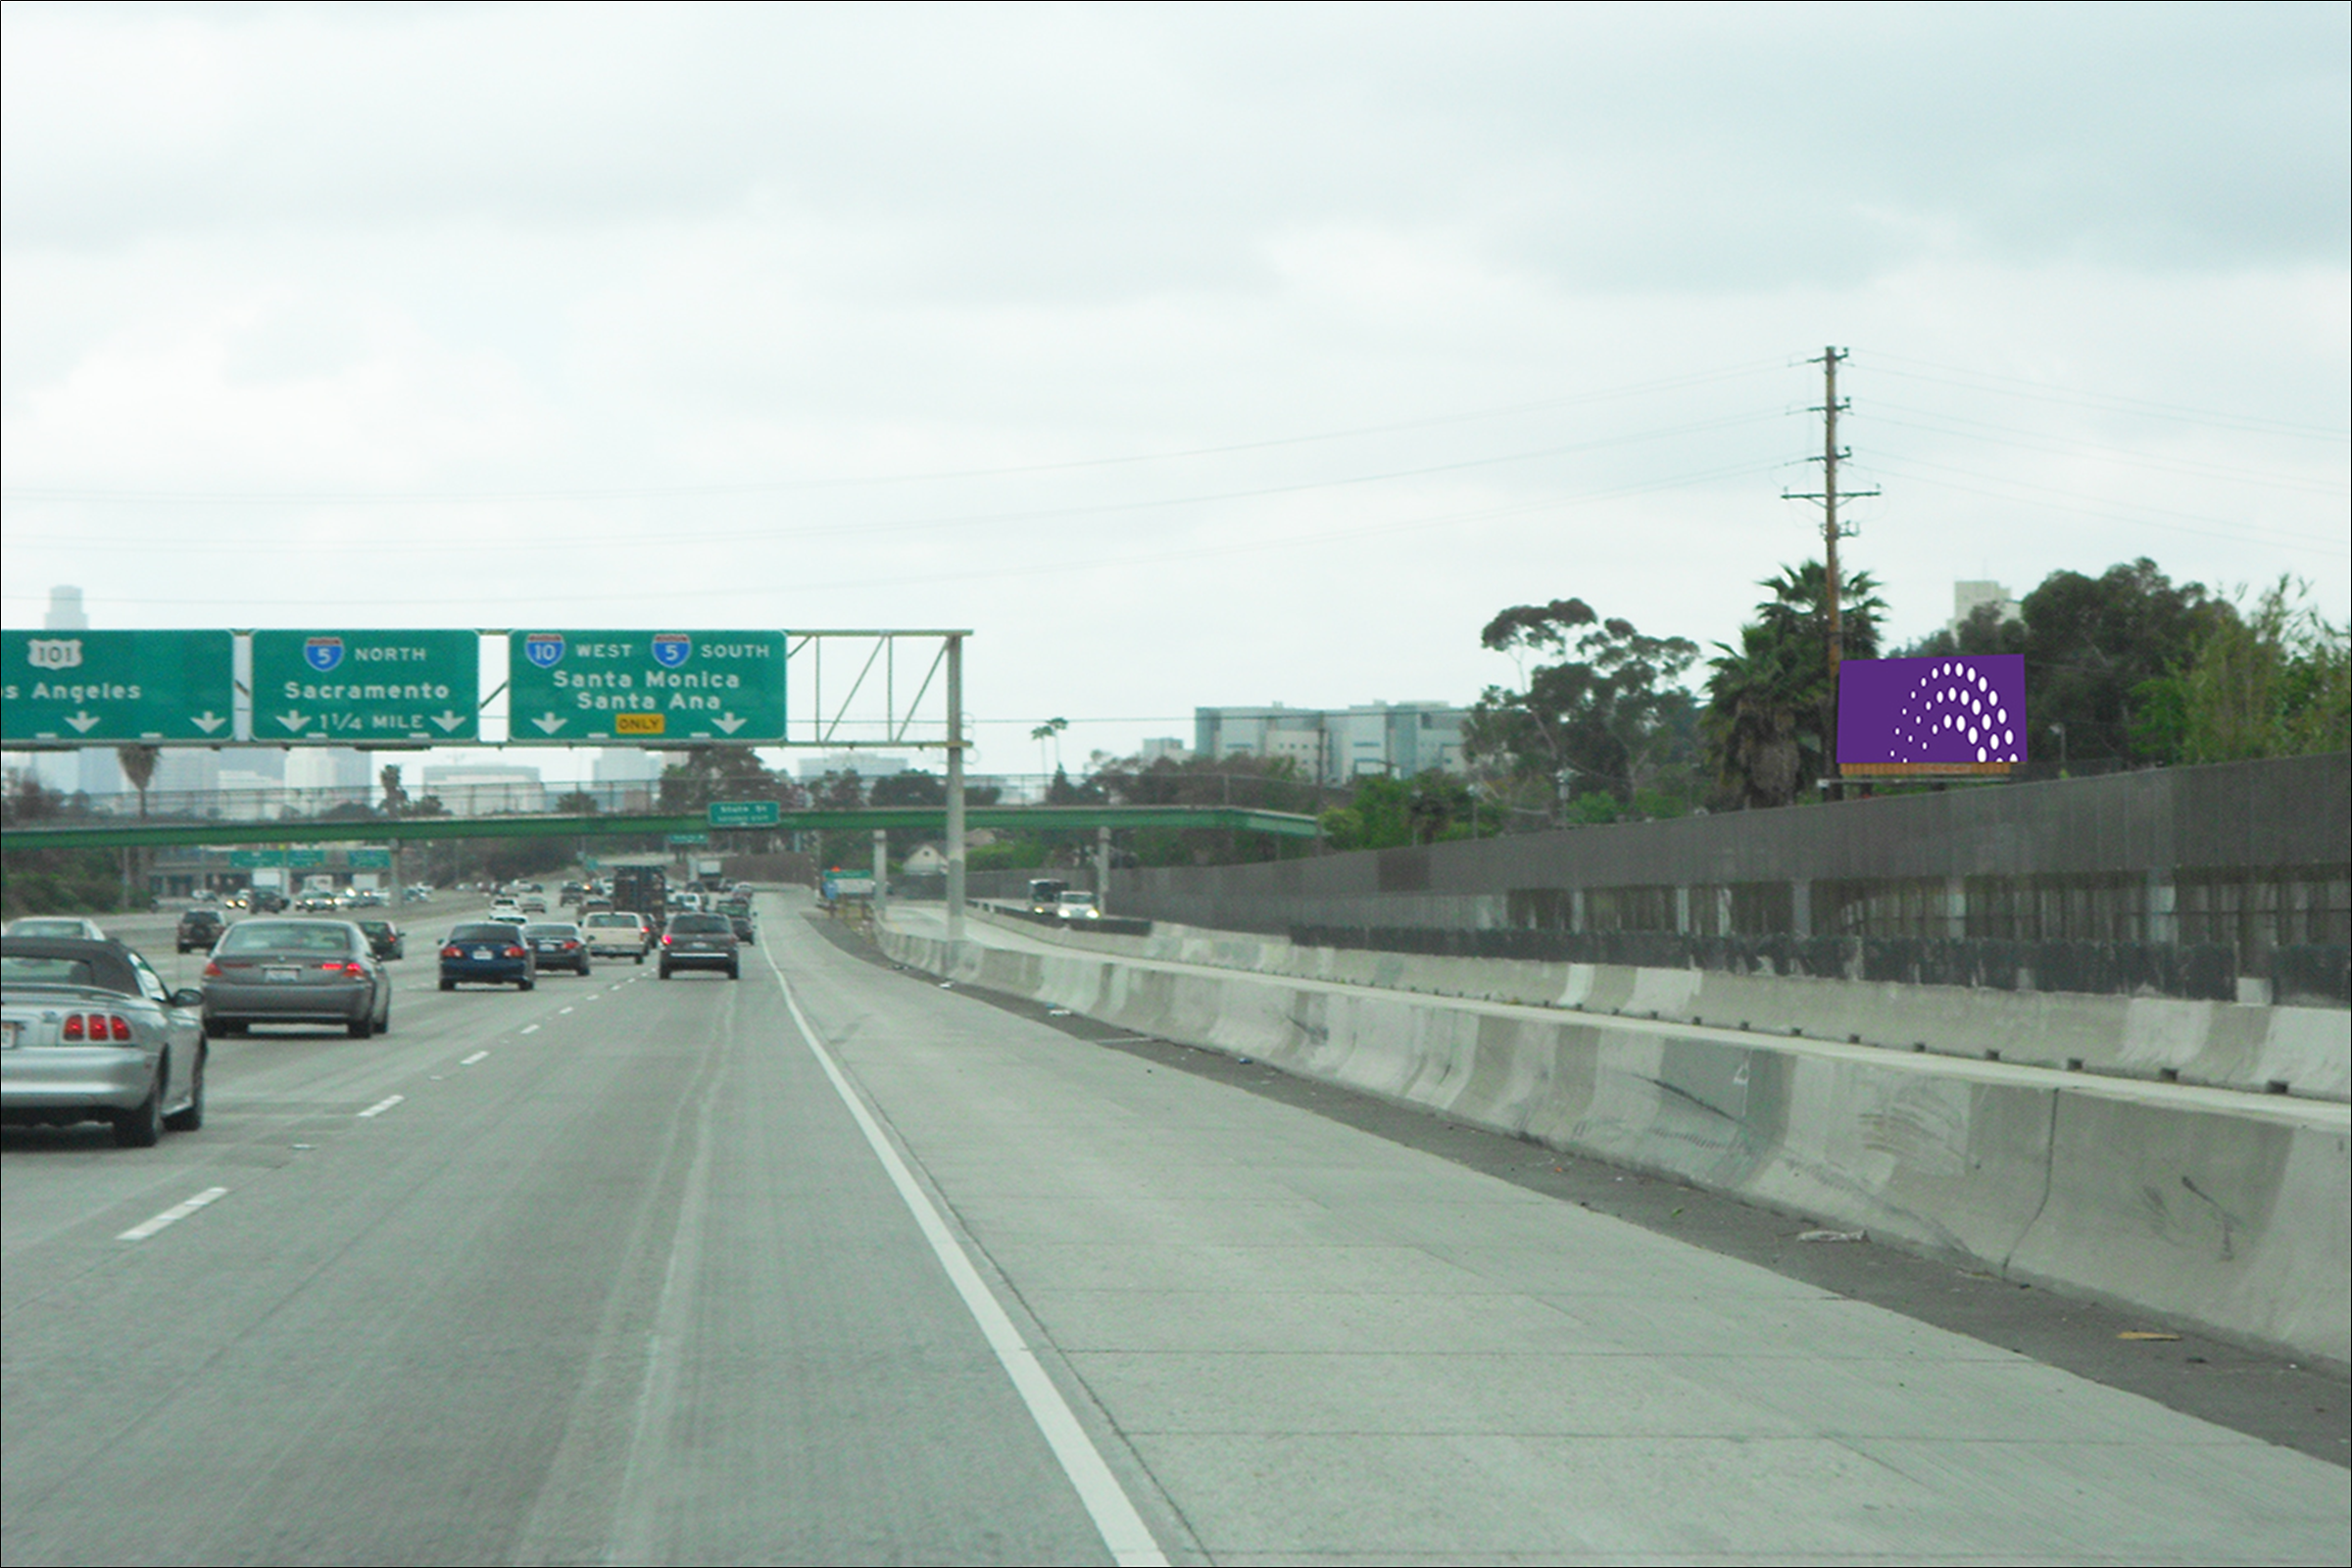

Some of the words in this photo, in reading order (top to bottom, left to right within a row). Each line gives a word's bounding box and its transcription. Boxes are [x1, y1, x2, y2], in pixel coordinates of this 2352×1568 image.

[37, 646, 73, 662] 101
[318, 648, 332, 664] 5
[355, 647, 426, 662] NORTH
[535, 644, 556, 661] 10
[575, 644, 633, 658] WEST
[664, 644, 679, 661] 5
[701, 644, 770, 658] SOUTH
[553, 670, 633, 688] Santa
[646, 670, 740, 688] Monica
[31, 682, 142, 704] Angeles
[284, 681, 450, 699] Sacramento
[577, 692, 657, 710] Santa
[668, 692, 721, 710] Ana
[371, 714, 424, 728] MILE
[618, 716, 662, 730] ONLY
